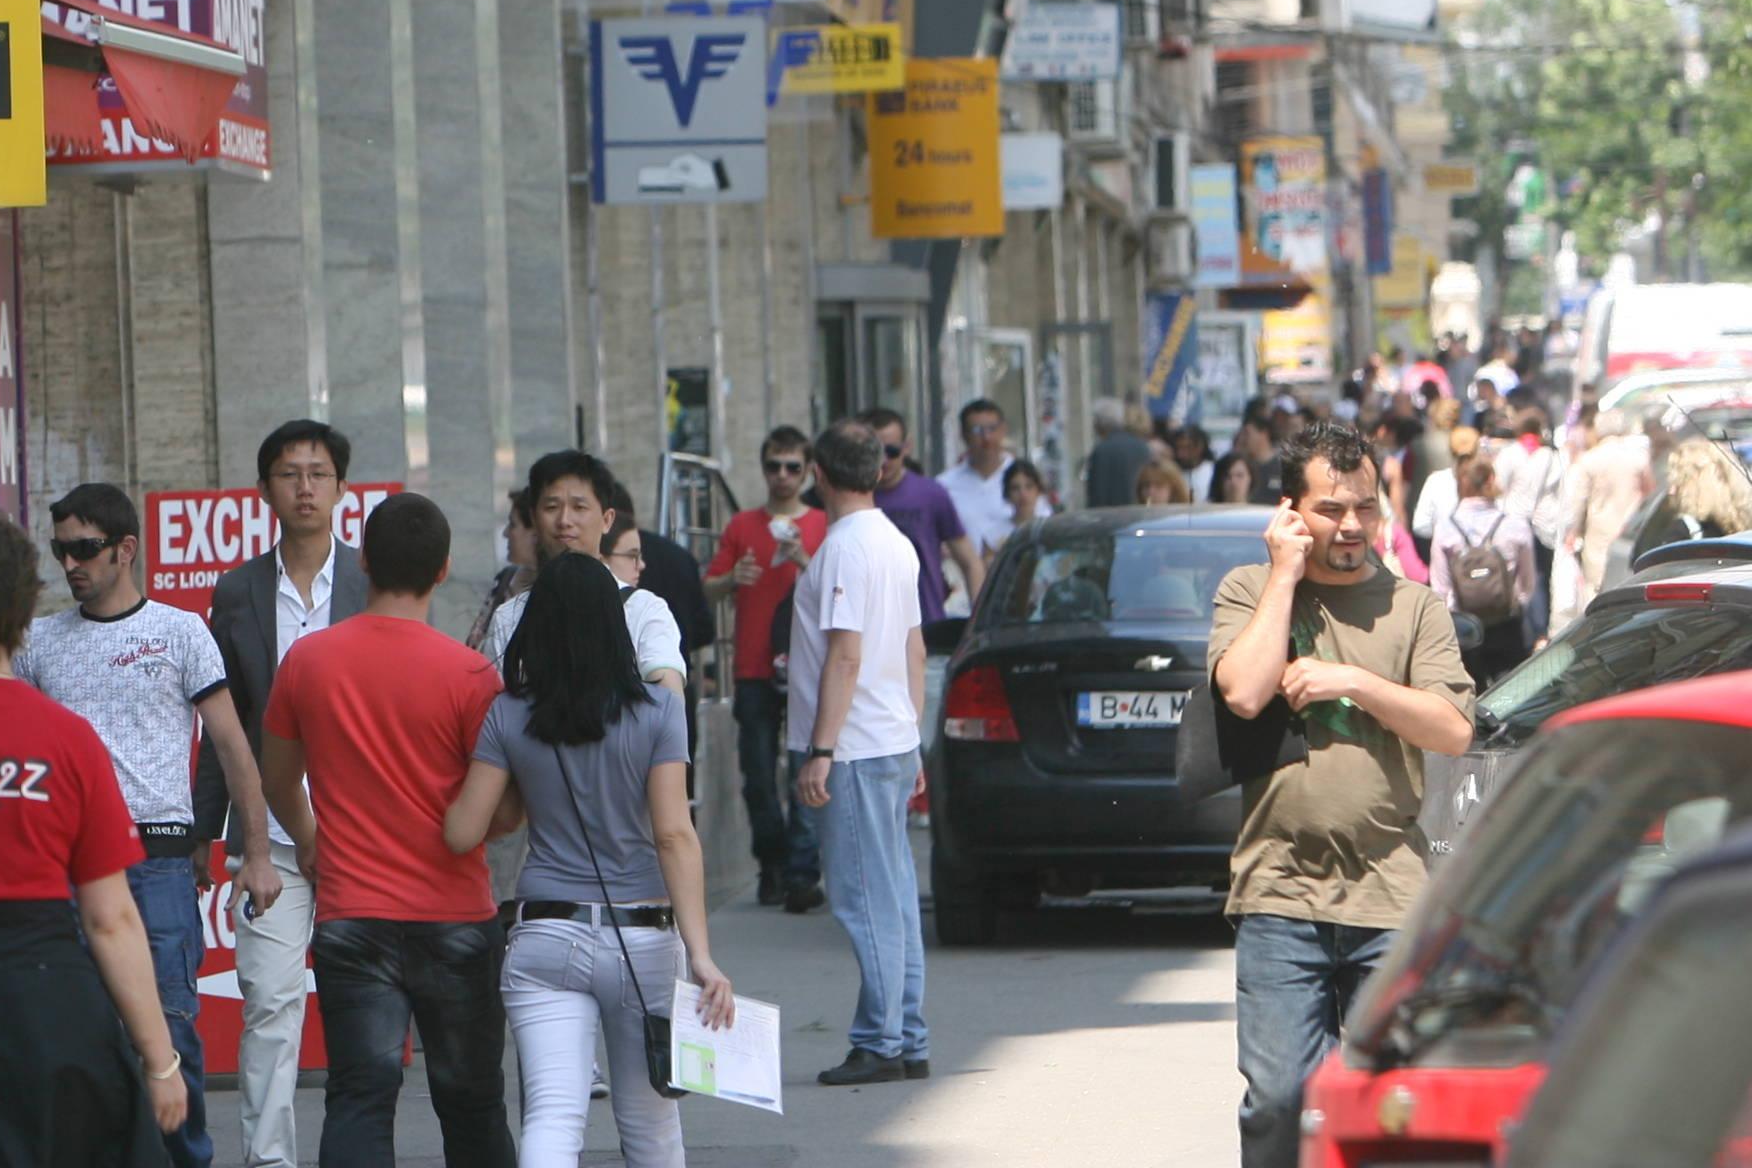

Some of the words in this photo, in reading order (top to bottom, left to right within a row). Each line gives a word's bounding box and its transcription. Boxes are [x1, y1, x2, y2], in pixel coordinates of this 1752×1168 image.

[893, 140, 925, 168] 24
[153, 572, 175, 589] SC
[1128, 694, 1159, 719] 44
